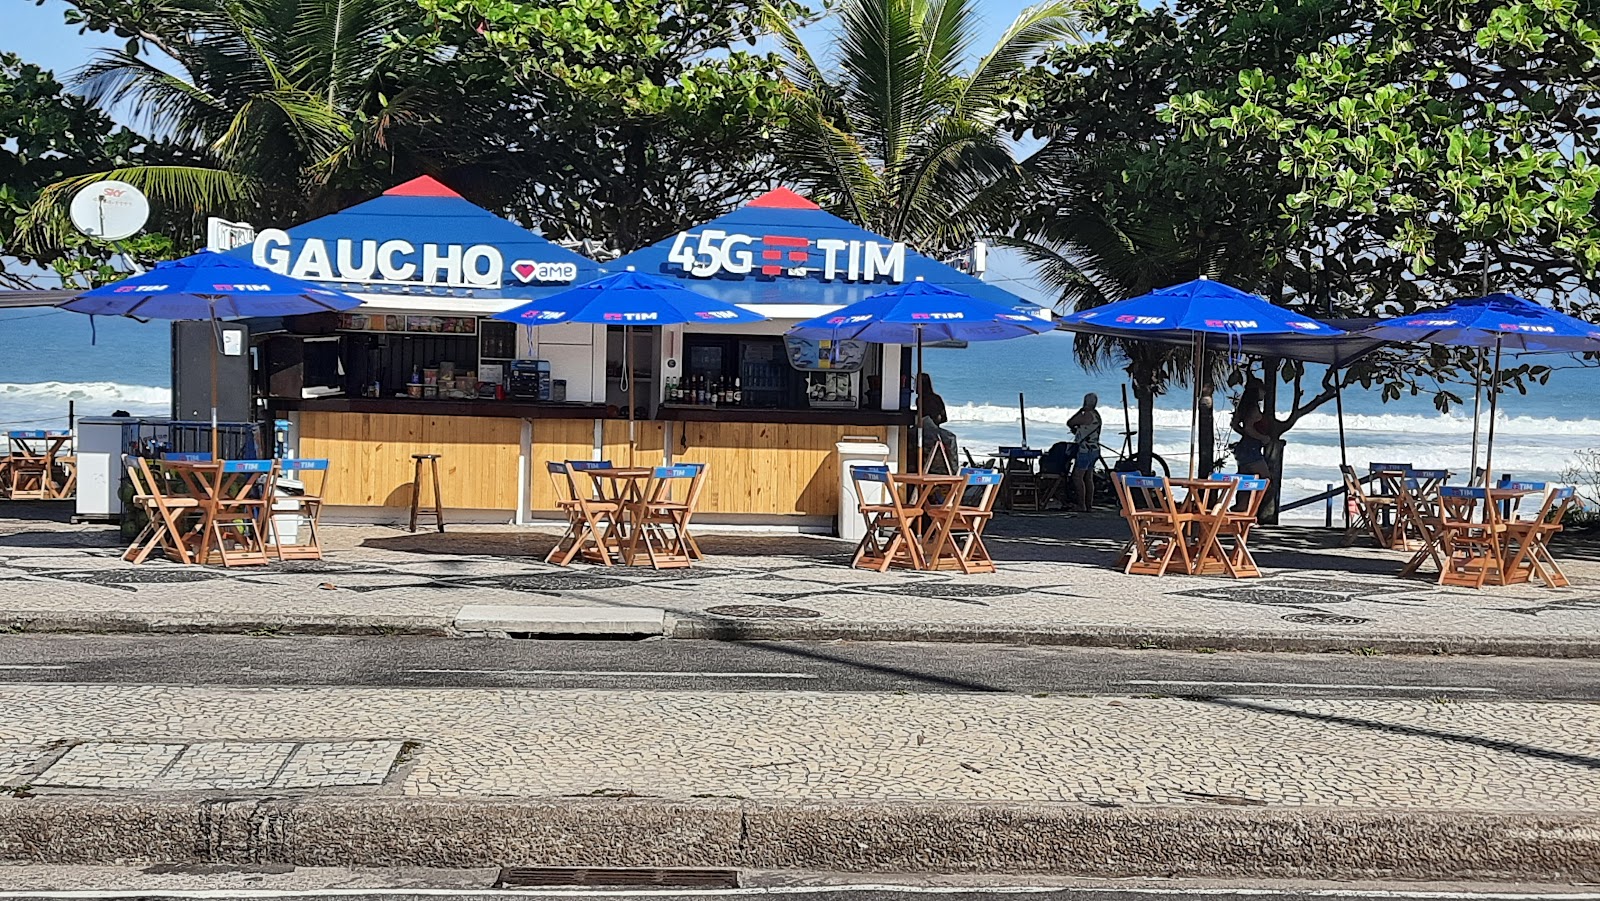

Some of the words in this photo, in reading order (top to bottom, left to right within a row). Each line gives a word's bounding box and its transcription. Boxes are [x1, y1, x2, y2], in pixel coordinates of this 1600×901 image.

[104, 188, 127, 197] SKY
[252, 228, 503, 285] GAUCHO
[816, 239, 905, 282] TIM
[539, 266, 573, 277] ame
[624, 312, 657, 320] TIM
[1135, 316, 1165, 324] TIM
